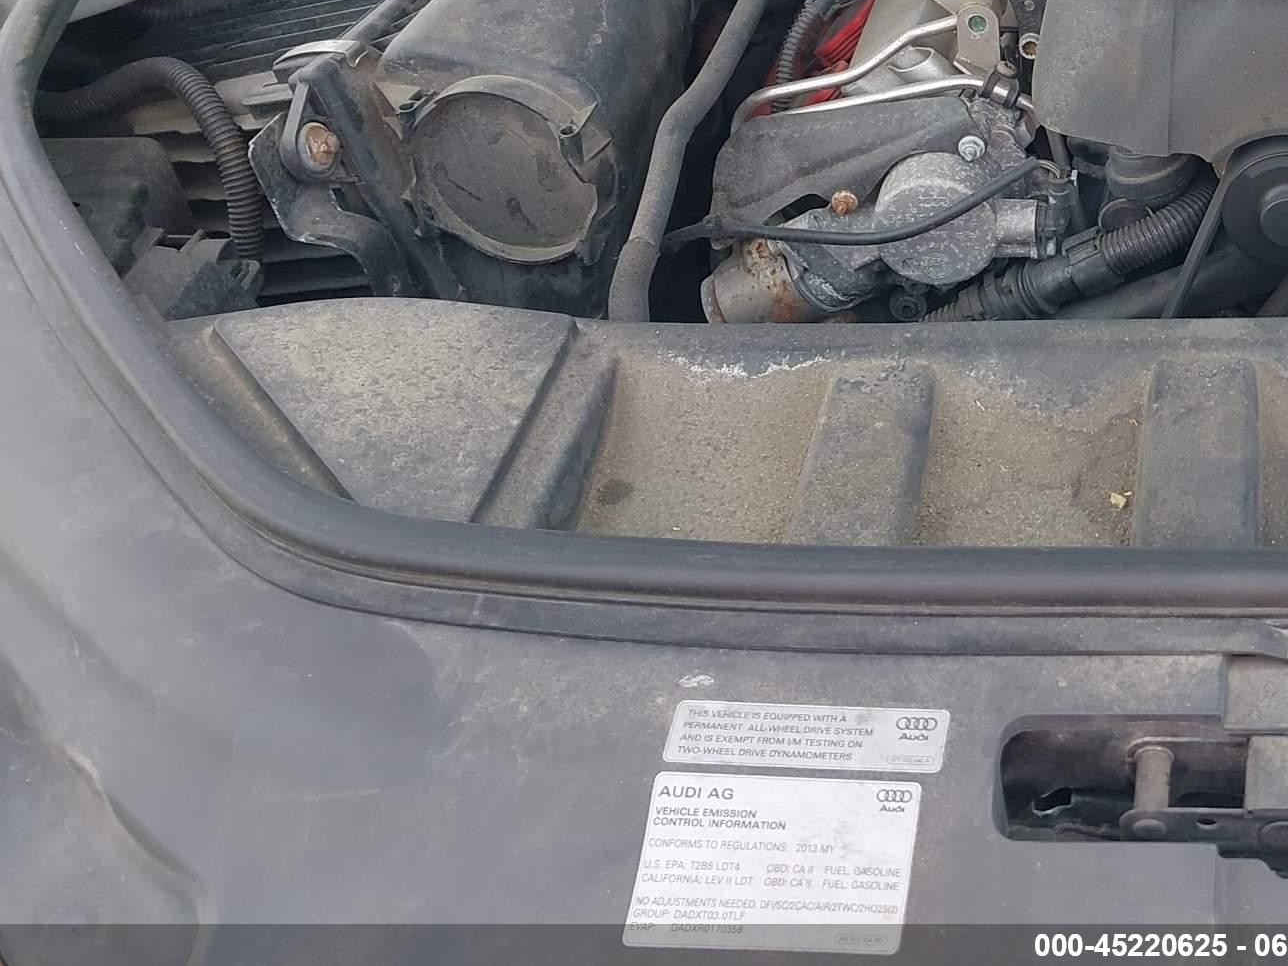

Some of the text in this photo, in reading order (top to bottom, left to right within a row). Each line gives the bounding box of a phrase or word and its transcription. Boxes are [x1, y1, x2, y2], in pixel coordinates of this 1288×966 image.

[688, 709, 847, 723] THIS VEHICLE IS EQUIPPED WITH A
[683, 721, 874, 737] PERMANENT ALL-WHEEL DRIVE SYSTEM
[680, 733, 702, 742] AND
[703, 734, 713, 743] IS
[715, 735, 755, 744] EXEMPT
[757, 736, 785, 746] FROM
[804, 738, 846, 748] TESTING
[847, 739, 863, 749] ON
[898, 733, 929, 742] Audi
[678, 745, 853, 761] TWO-WHEEL DRIVE DYNAMOMETERS
[658, 785, 735, 800] AUDI AG
[655, 806, 758, 819] VEHICLE EMISSION
[880, 804, 905, 813] Audi
[653, 816, 787, 830] CONTROL INFORMATION
[649, 837, 703, 849] CONFORMS
[705, 839, 719, 850] TO
[795, 842, 818, 853] 2013
[820, 843, 835, 854] MY
[644, 859, 662, 869] U.S.
[716, 861, 741, 872] LDT4
[792, 864, 806, 874] CA
[853, 866, 902, 878] GASOLINE
[705, 874, 726, 885] LEV
[790, 877, 804, 888] CA
[851, 879, 900, 891] GASOLINE
[635, 896, 650, 906] NO
[651, 896, 718, 908] ADJUSTMENTS
